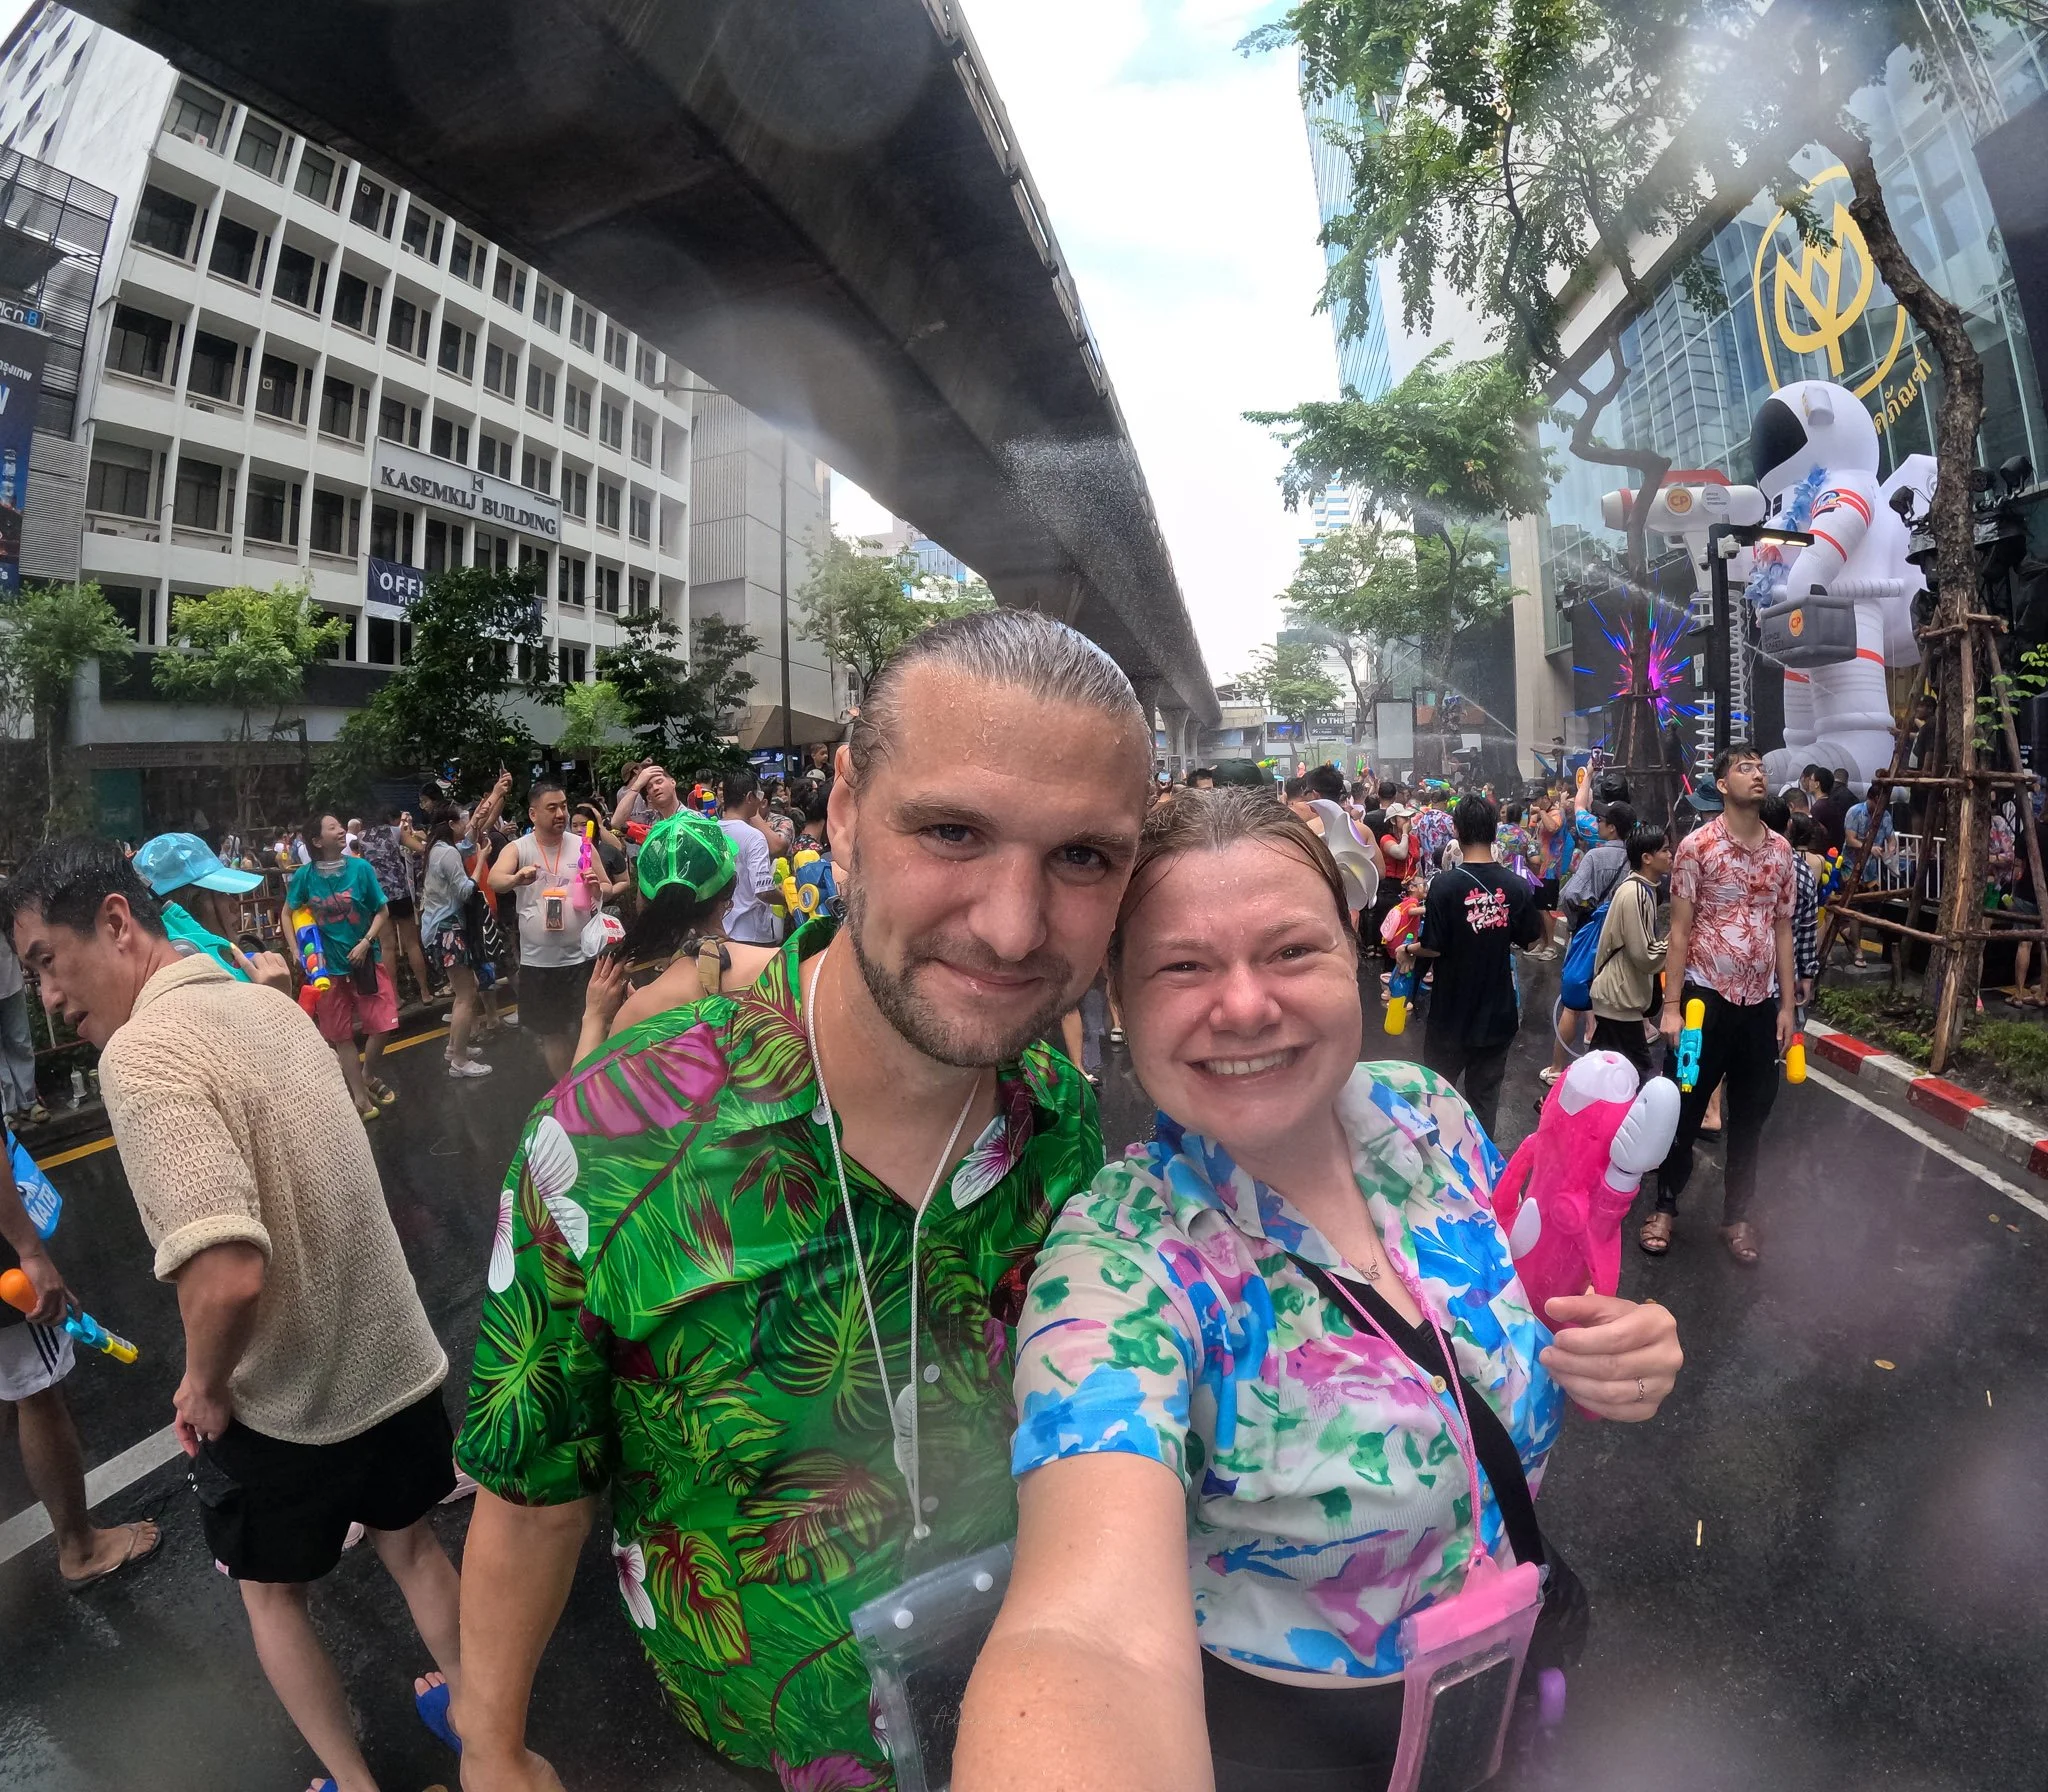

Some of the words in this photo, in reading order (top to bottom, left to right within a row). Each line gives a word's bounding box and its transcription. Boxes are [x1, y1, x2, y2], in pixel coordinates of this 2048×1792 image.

[1874, 351, 1932, 435] คภัณฑ์
[380, 465, 477, 510] KASEMKIJ
[481, 497, 557, 535] BUILDING
[1669, 495, 1688, 506] CP
[380, 572, 424, 598] OFFI
[1316, 717, 1328, 725] TO
[1328, 717, 1344, 725] THE
